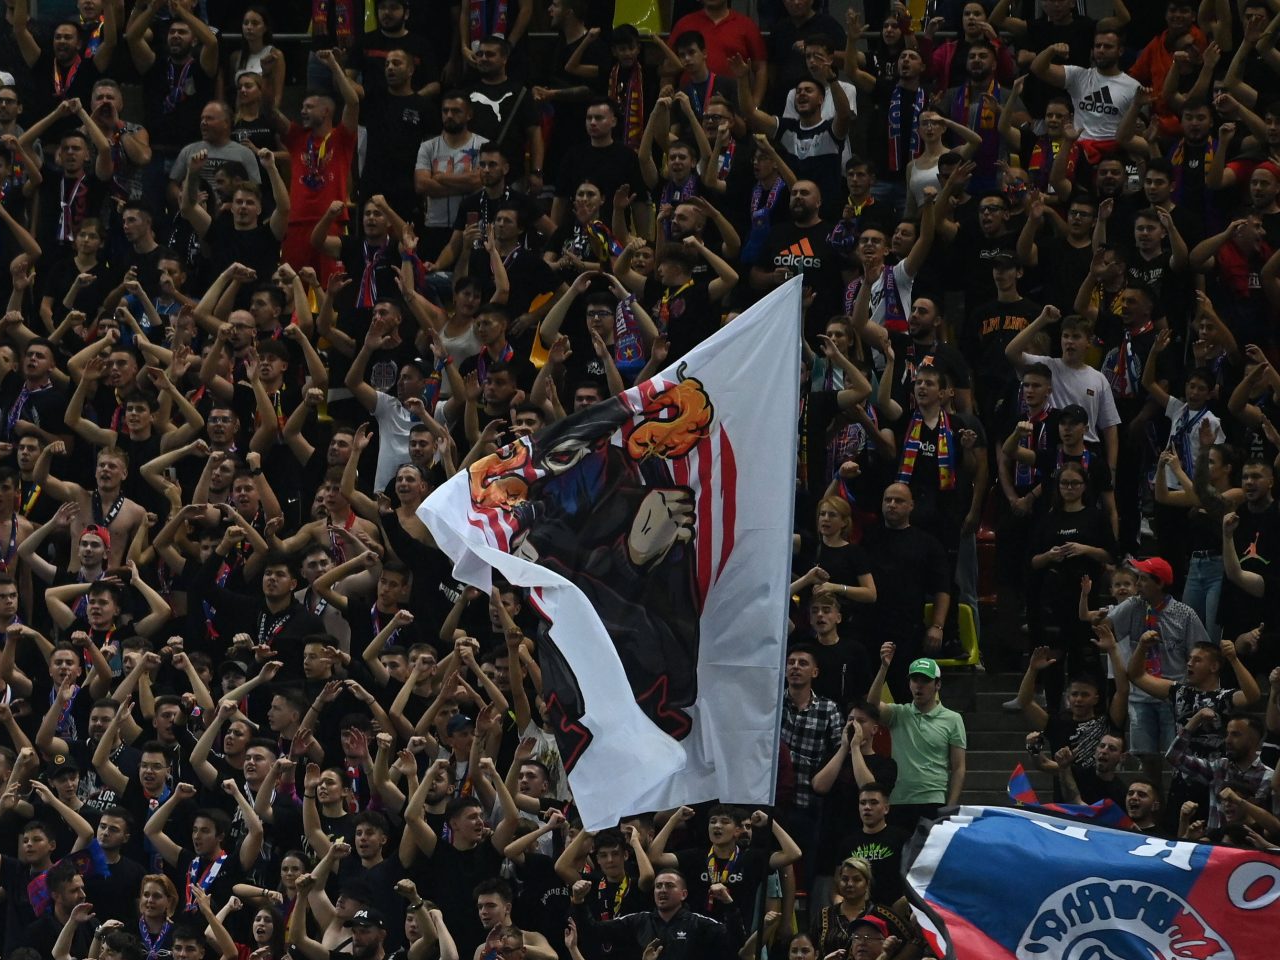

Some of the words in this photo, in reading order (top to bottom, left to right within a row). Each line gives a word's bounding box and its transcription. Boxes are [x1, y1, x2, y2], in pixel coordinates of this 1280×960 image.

[1079, 99, 1119, 115] adidas
[773, 254, 821, 267] adidas
[97, 789, 115, 800] LOS
